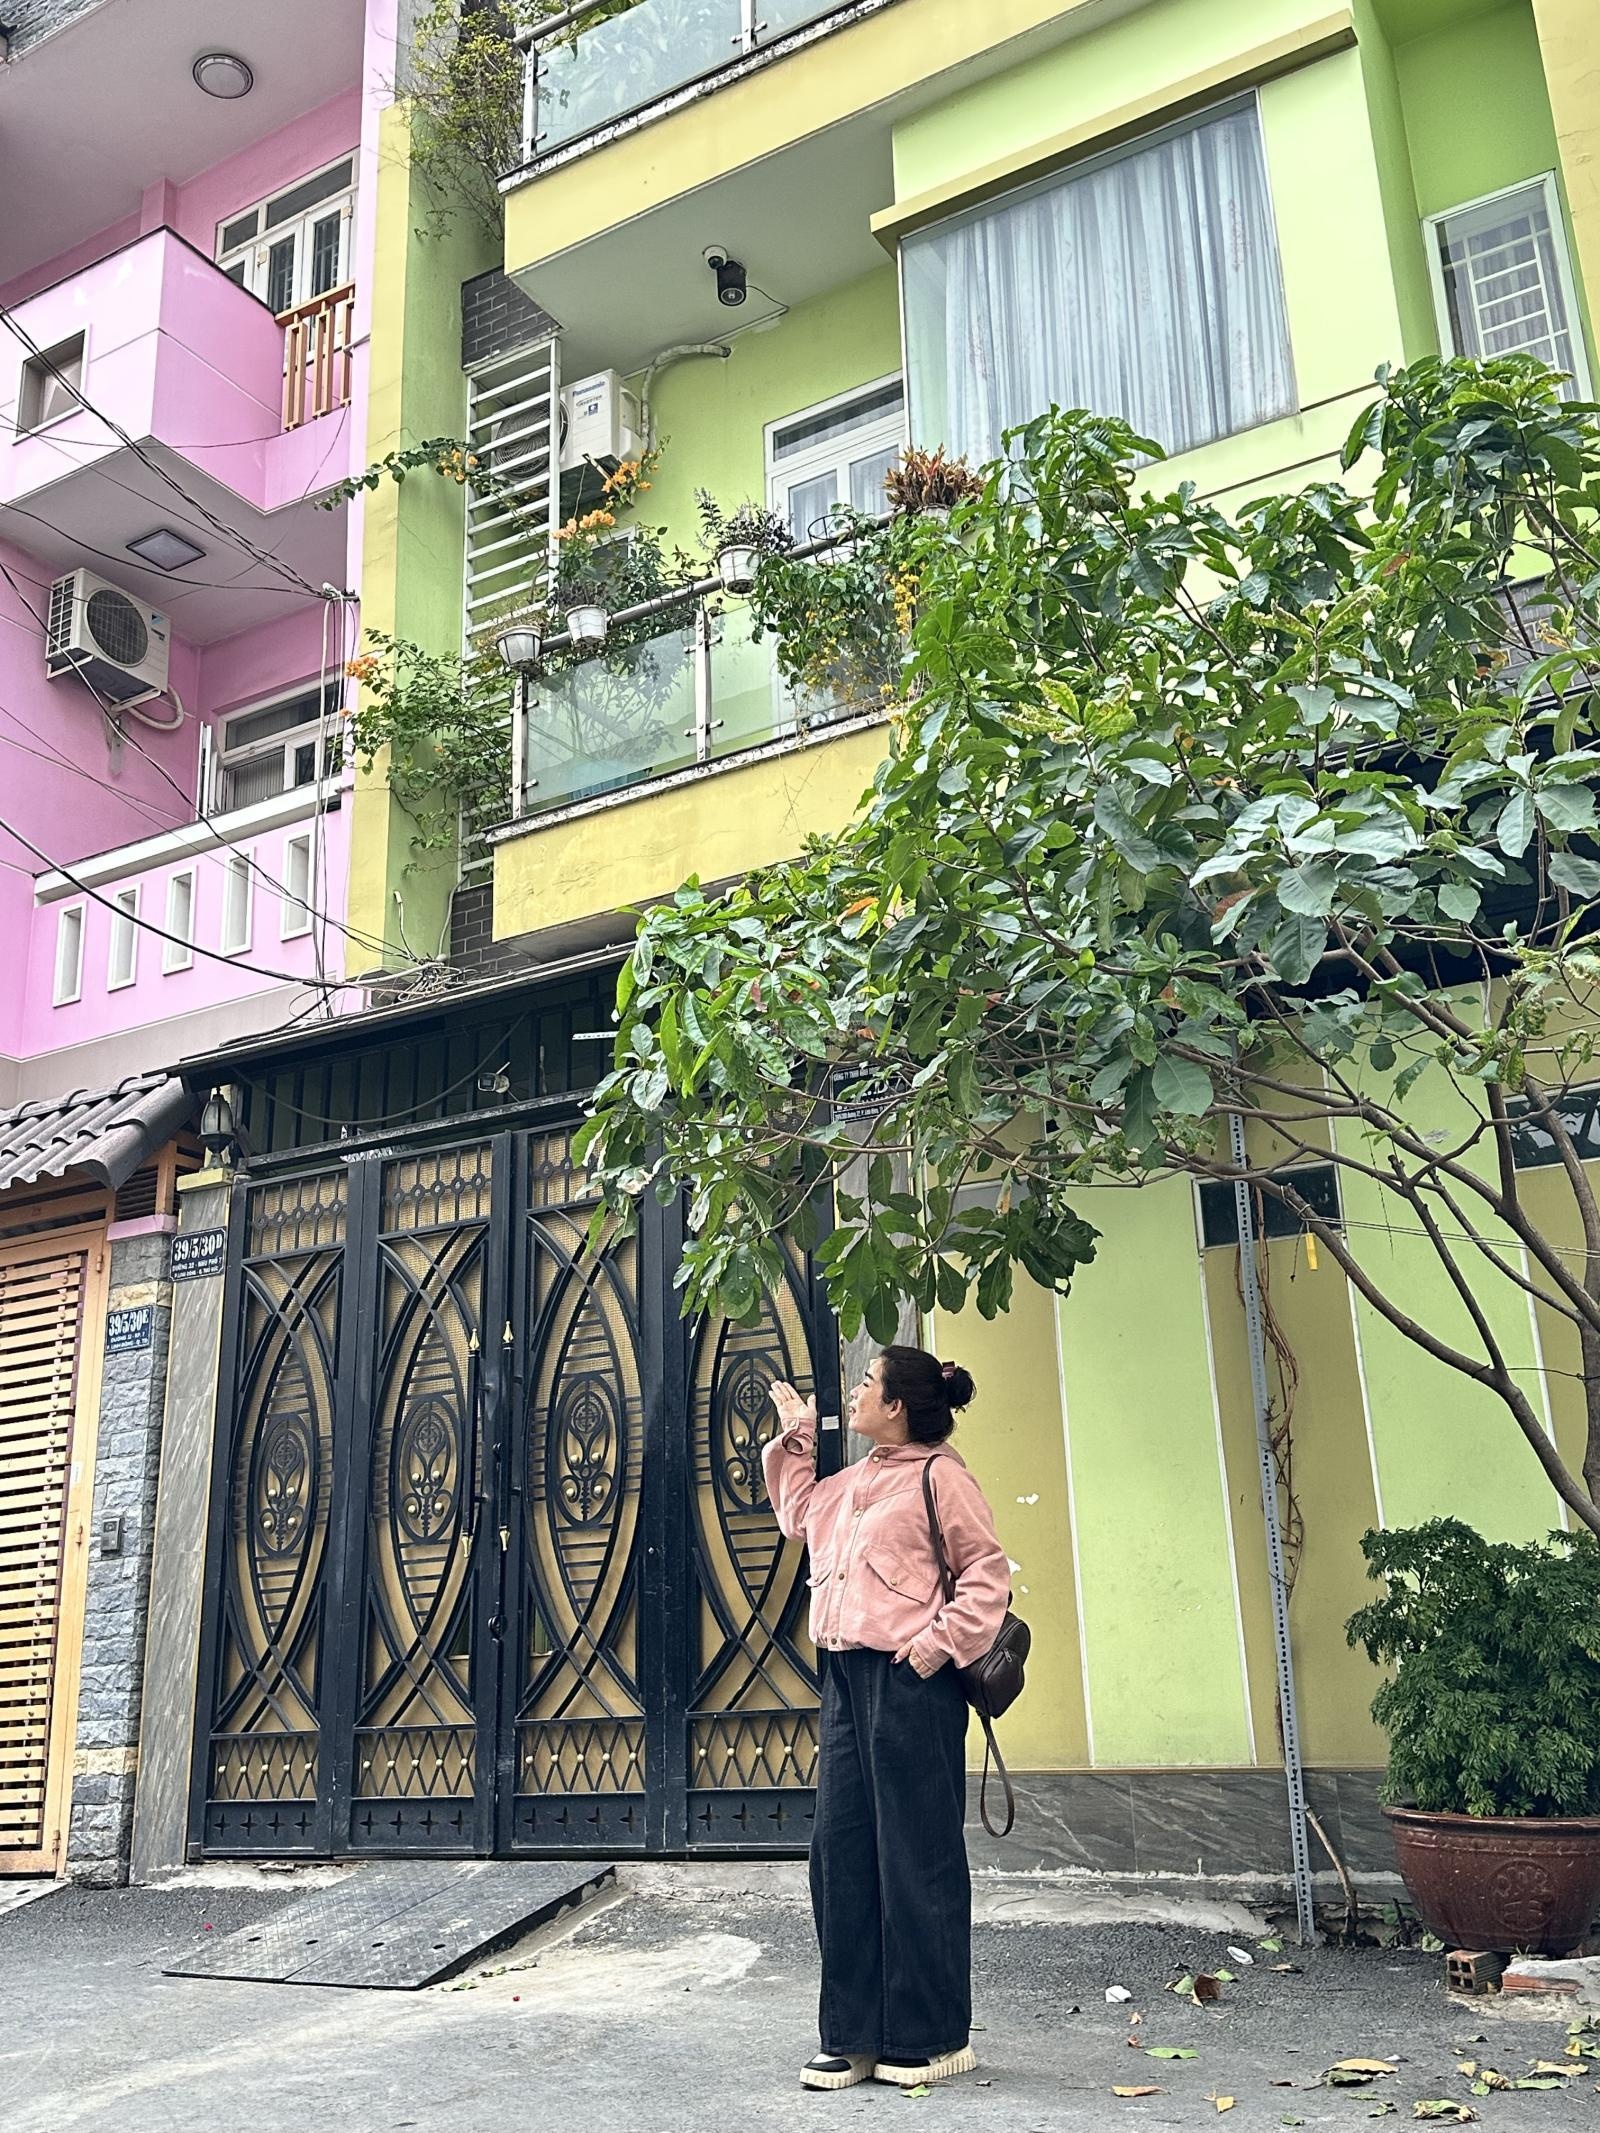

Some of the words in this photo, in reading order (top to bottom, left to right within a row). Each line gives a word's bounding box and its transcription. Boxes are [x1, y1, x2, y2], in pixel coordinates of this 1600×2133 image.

[573, 381, 605, 397] Panasonic
[174, 1234, 223, 1261] 39/5/30D
[109, 1309, 149, 1337] 39/5/30E
